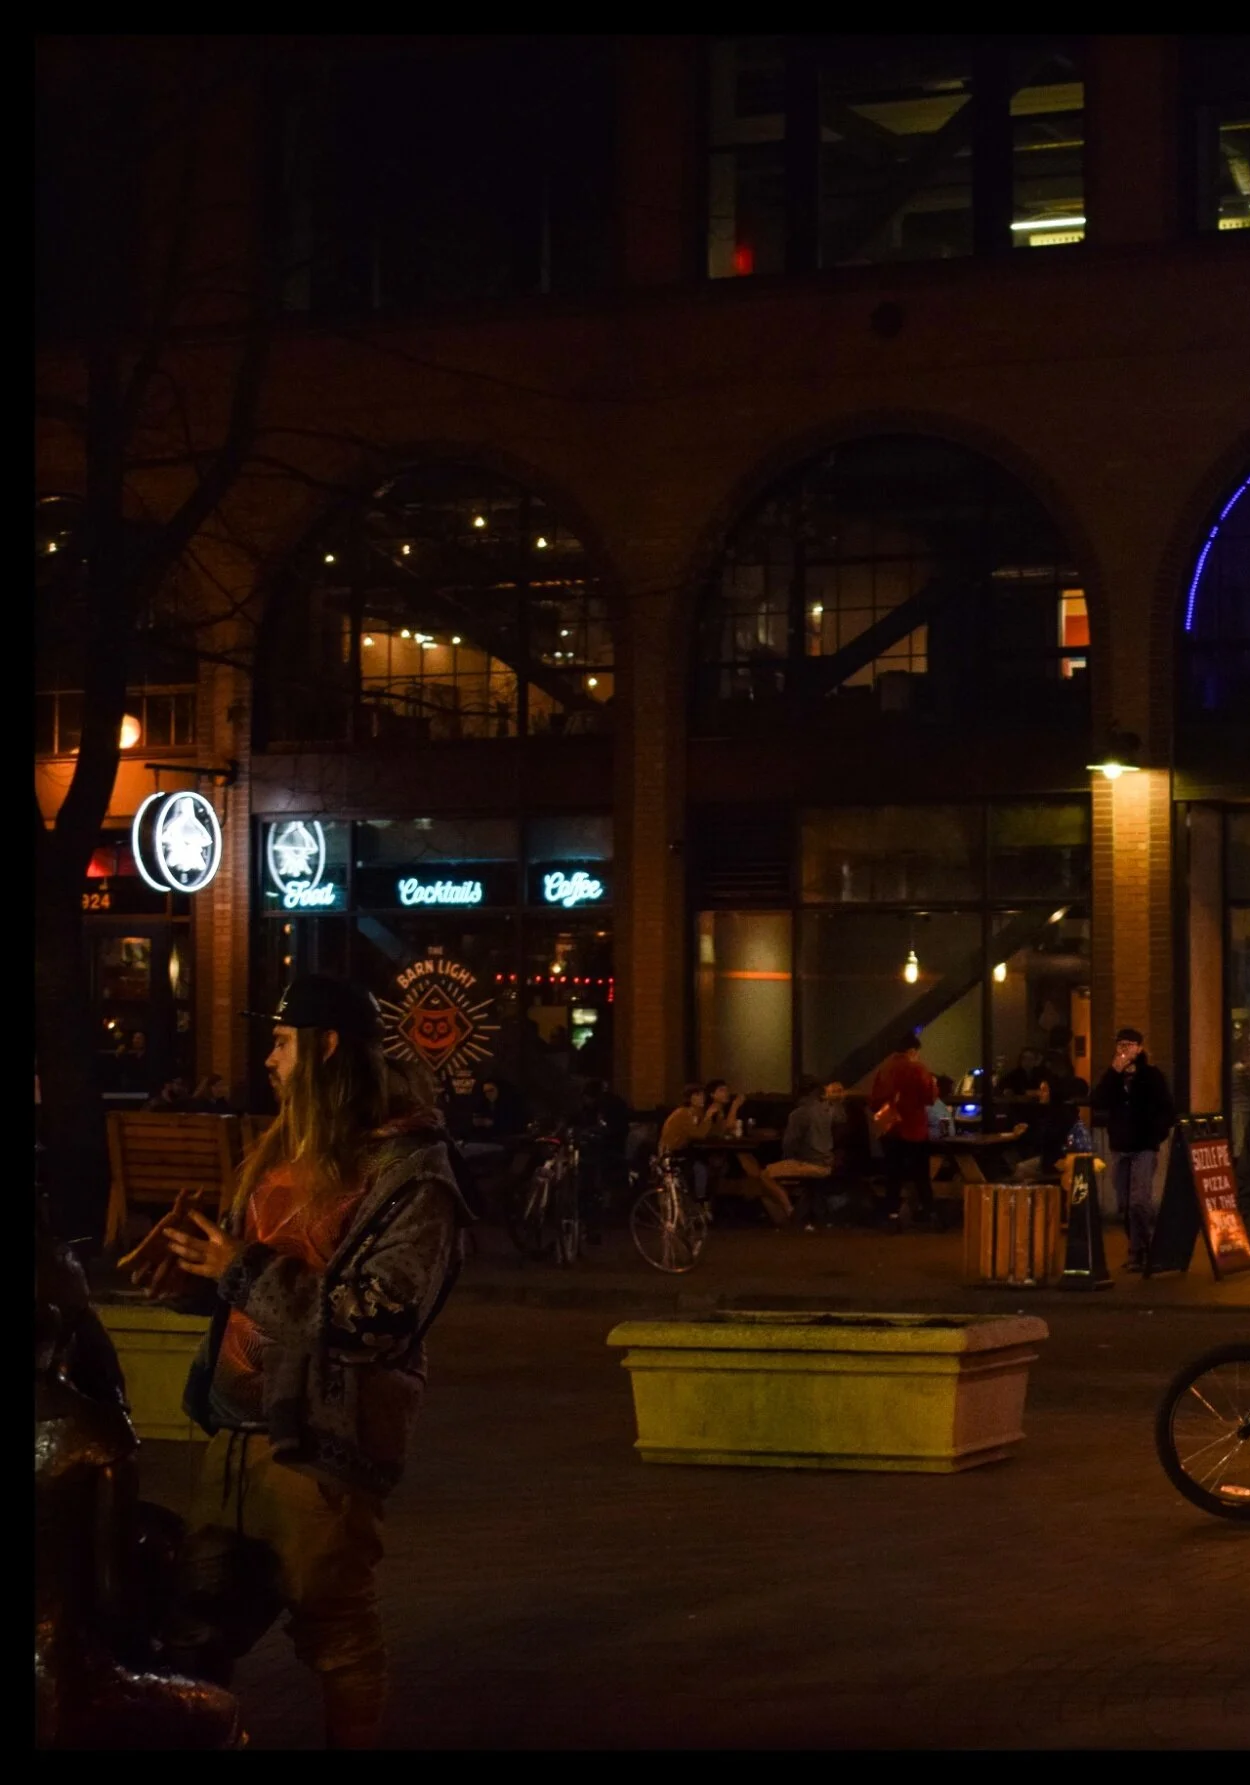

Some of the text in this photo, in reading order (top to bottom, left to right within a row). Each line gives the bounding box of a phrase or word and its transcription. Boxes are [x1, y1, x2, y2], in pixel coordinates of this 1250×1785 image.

[283, 880, 335, 909] Food
[398, 877, 482, 906] Cocktails
[544, 871, 603, 908] Coffee
[395, 959, 478, 990] BARN LIGHT
[1202, 1175, 1231, 1193] PIZZA
